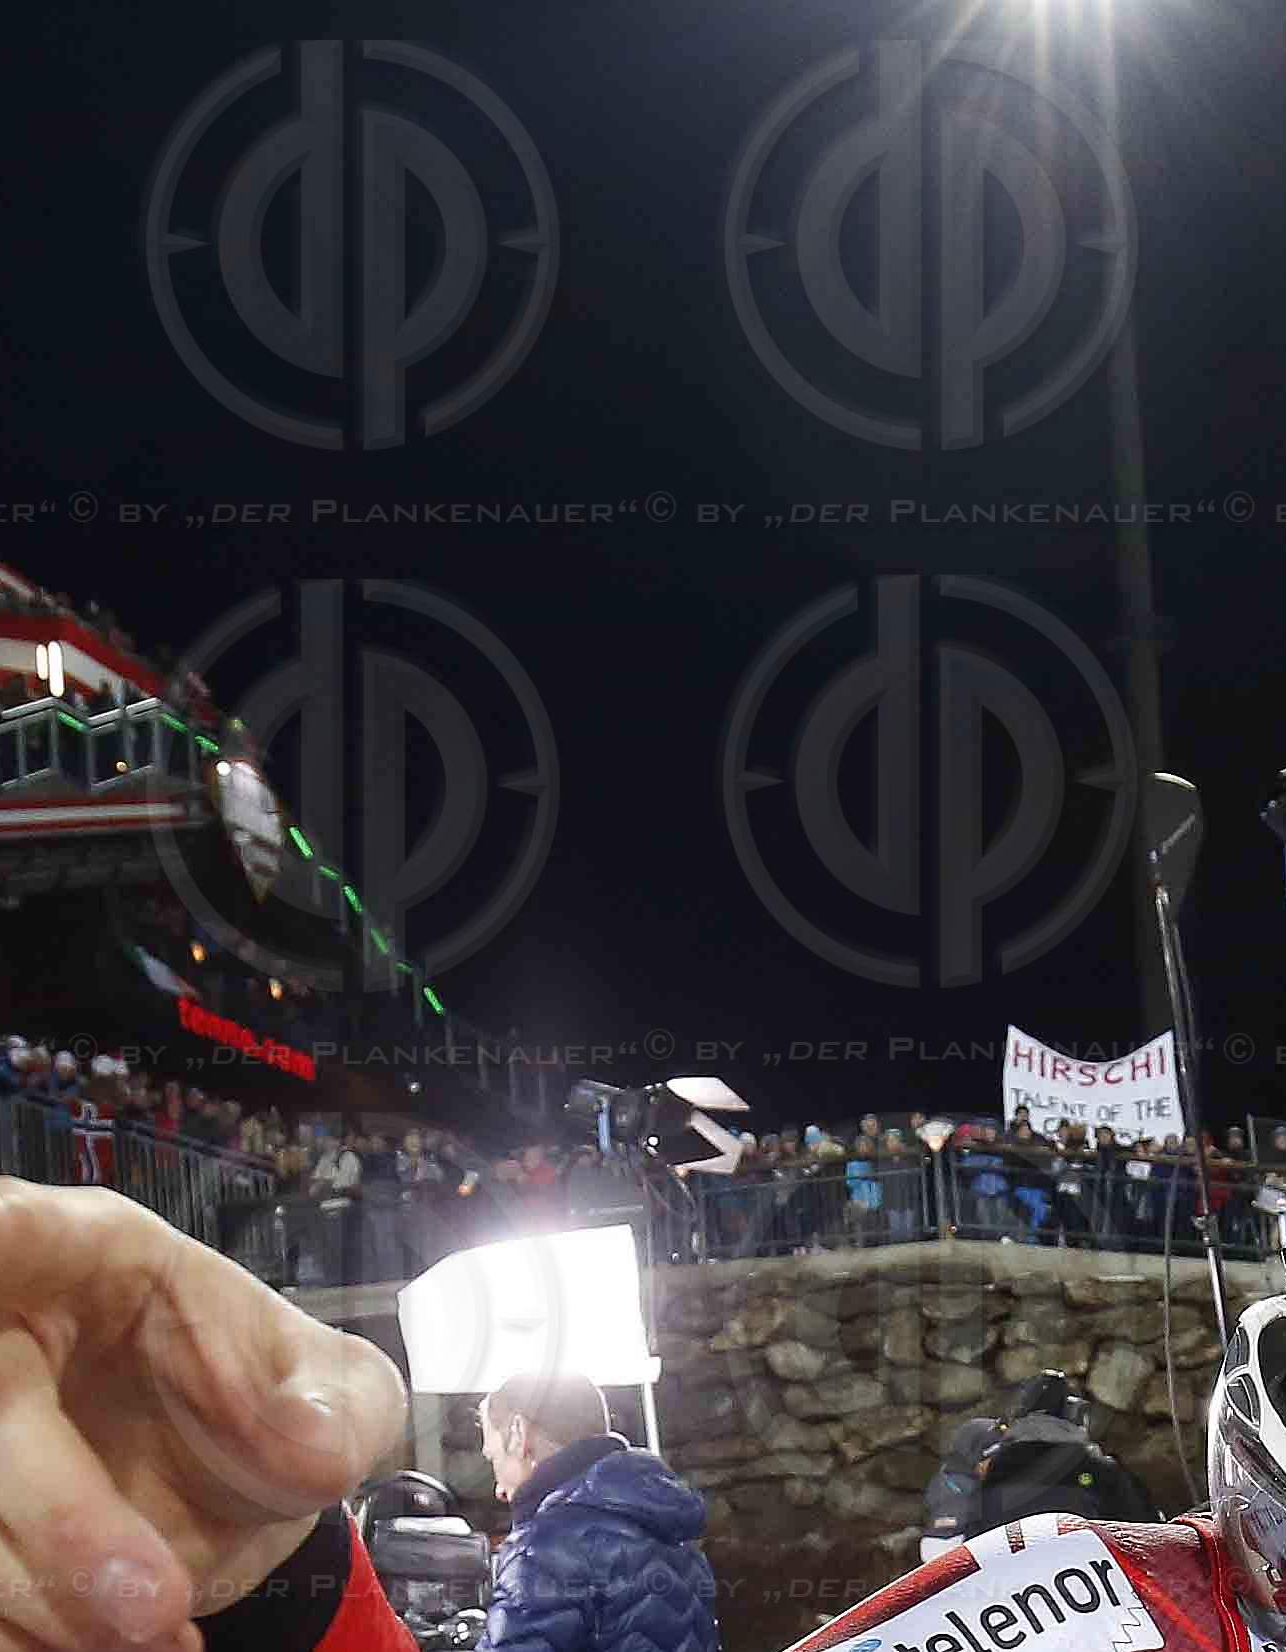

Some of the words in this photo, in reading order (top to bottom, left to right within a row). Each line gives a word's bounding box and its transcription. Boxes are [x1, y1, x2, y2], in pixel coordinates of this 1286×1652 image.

[1013, 1040, 1166, 1086] HIRSCHI
[1097, 1103, 1123, 1122] OF
[1134, 1097, 1172, 1120] THE
